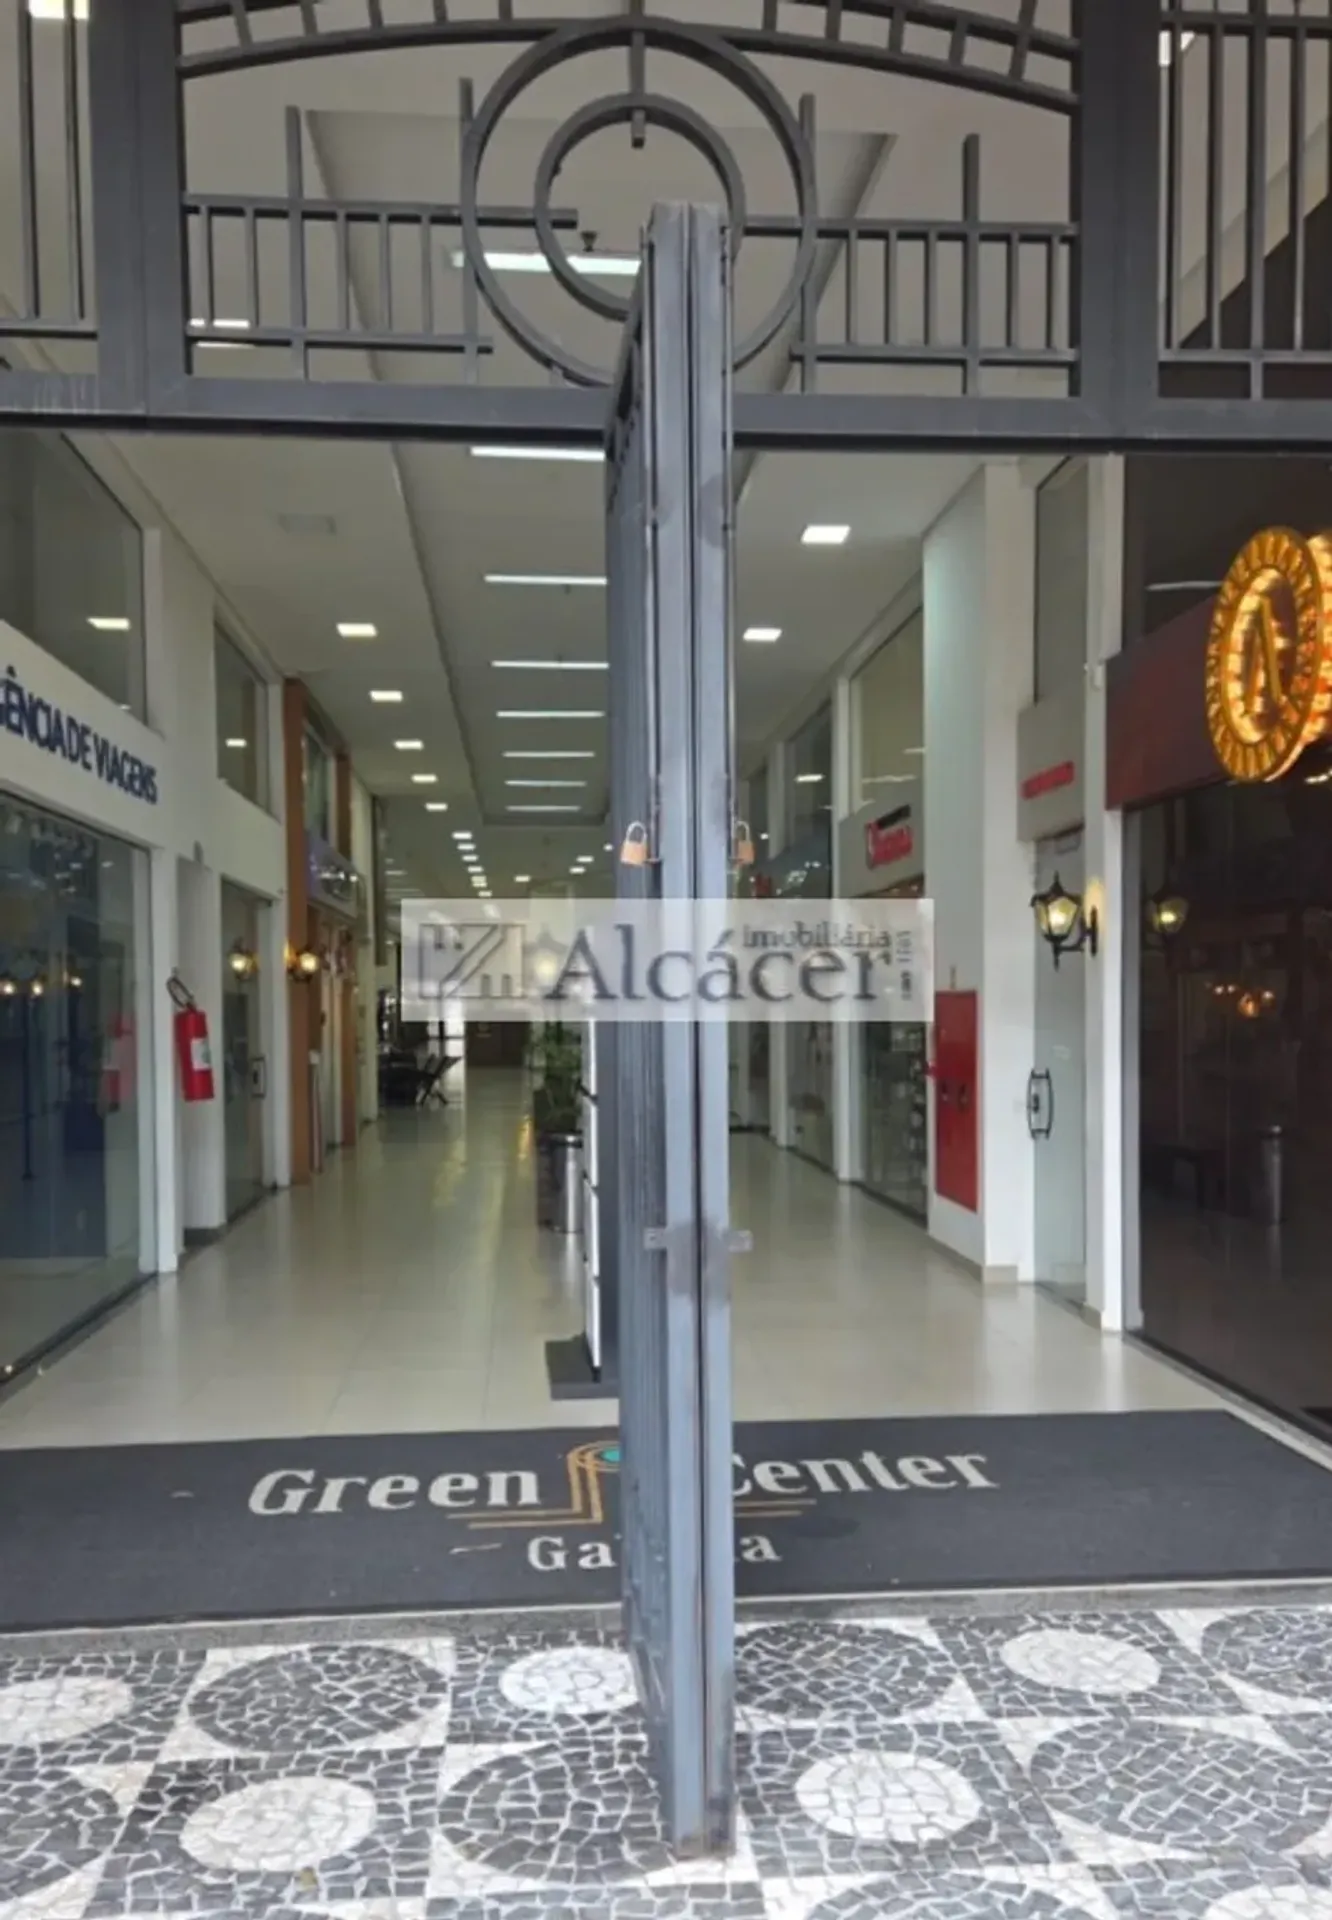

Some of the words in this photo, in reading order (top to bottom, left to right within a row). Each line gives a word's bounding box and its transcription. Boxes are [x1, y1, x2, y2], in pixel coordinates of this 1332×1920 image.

[67, 714, 93, 772] DE
[93, 732, 158, 805] VIAGENS
[248, 1468, 541, 1516] Green
